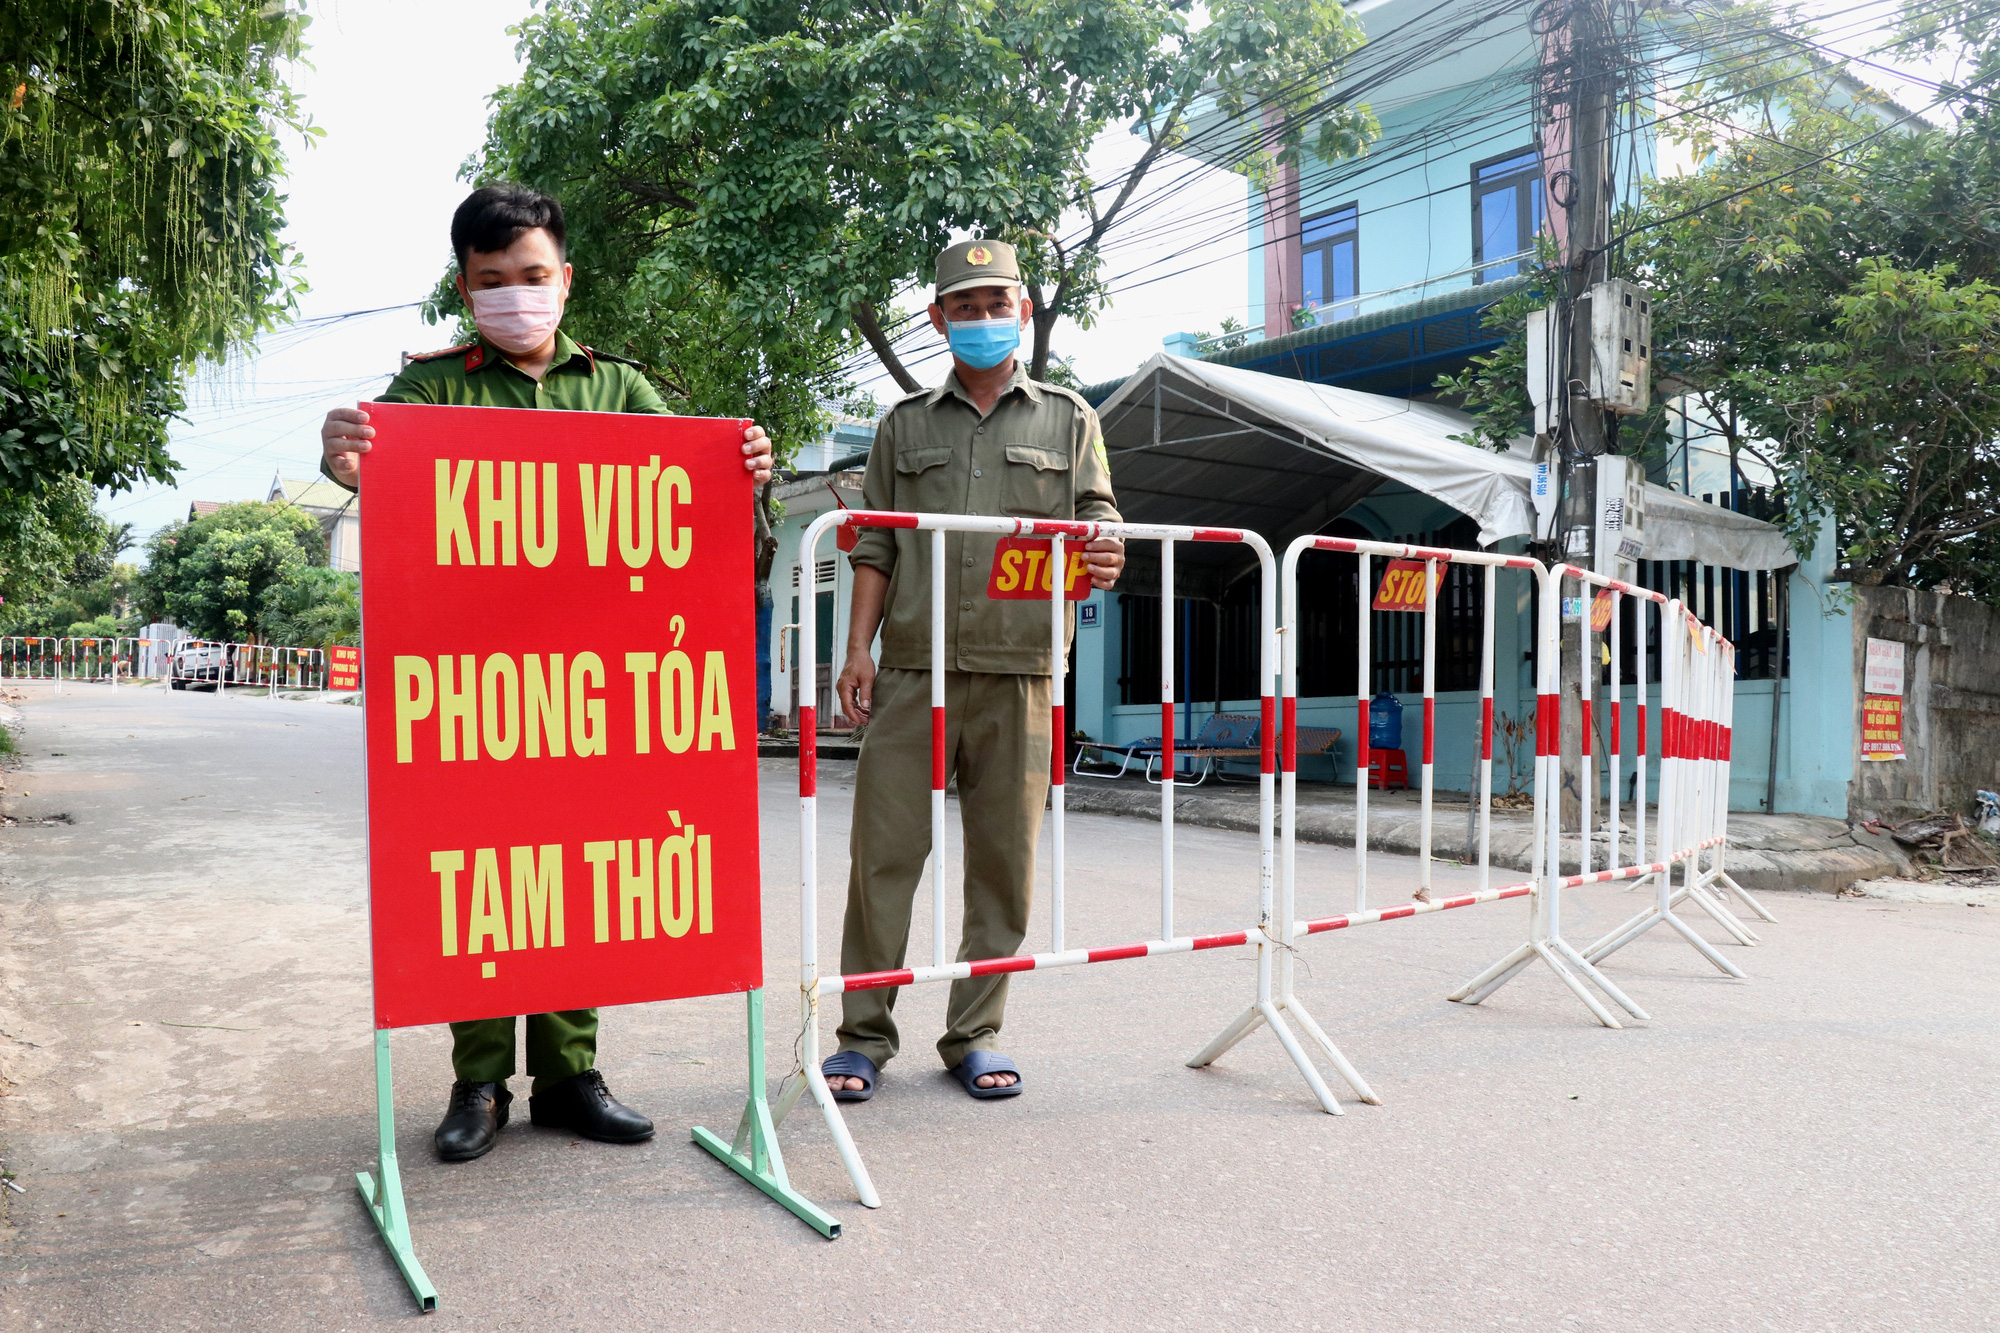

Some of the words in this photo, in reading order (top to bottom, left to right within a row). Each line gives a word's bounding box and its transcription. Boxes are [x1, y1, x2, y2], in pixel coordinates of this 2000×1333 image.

[434, 458, 559, 569] KHU
[578, 454, 693, 592] VỰC
[996, 548, 1090, 592] STOP
[1084, 607, 1094, 618] 18
[332, 662, 348, 672] PHONG
[336, 649, 346, 659] KHU
[347, 650, 357, 661] VỰC
[333, 676, 343, 687] TẠM
[393, 651, 607, 765] PHONG
[624, 614, 736, 758] TỎA
[430, 843, 565, 979] TẠM
[583, 809, 714, 944] THỜI
